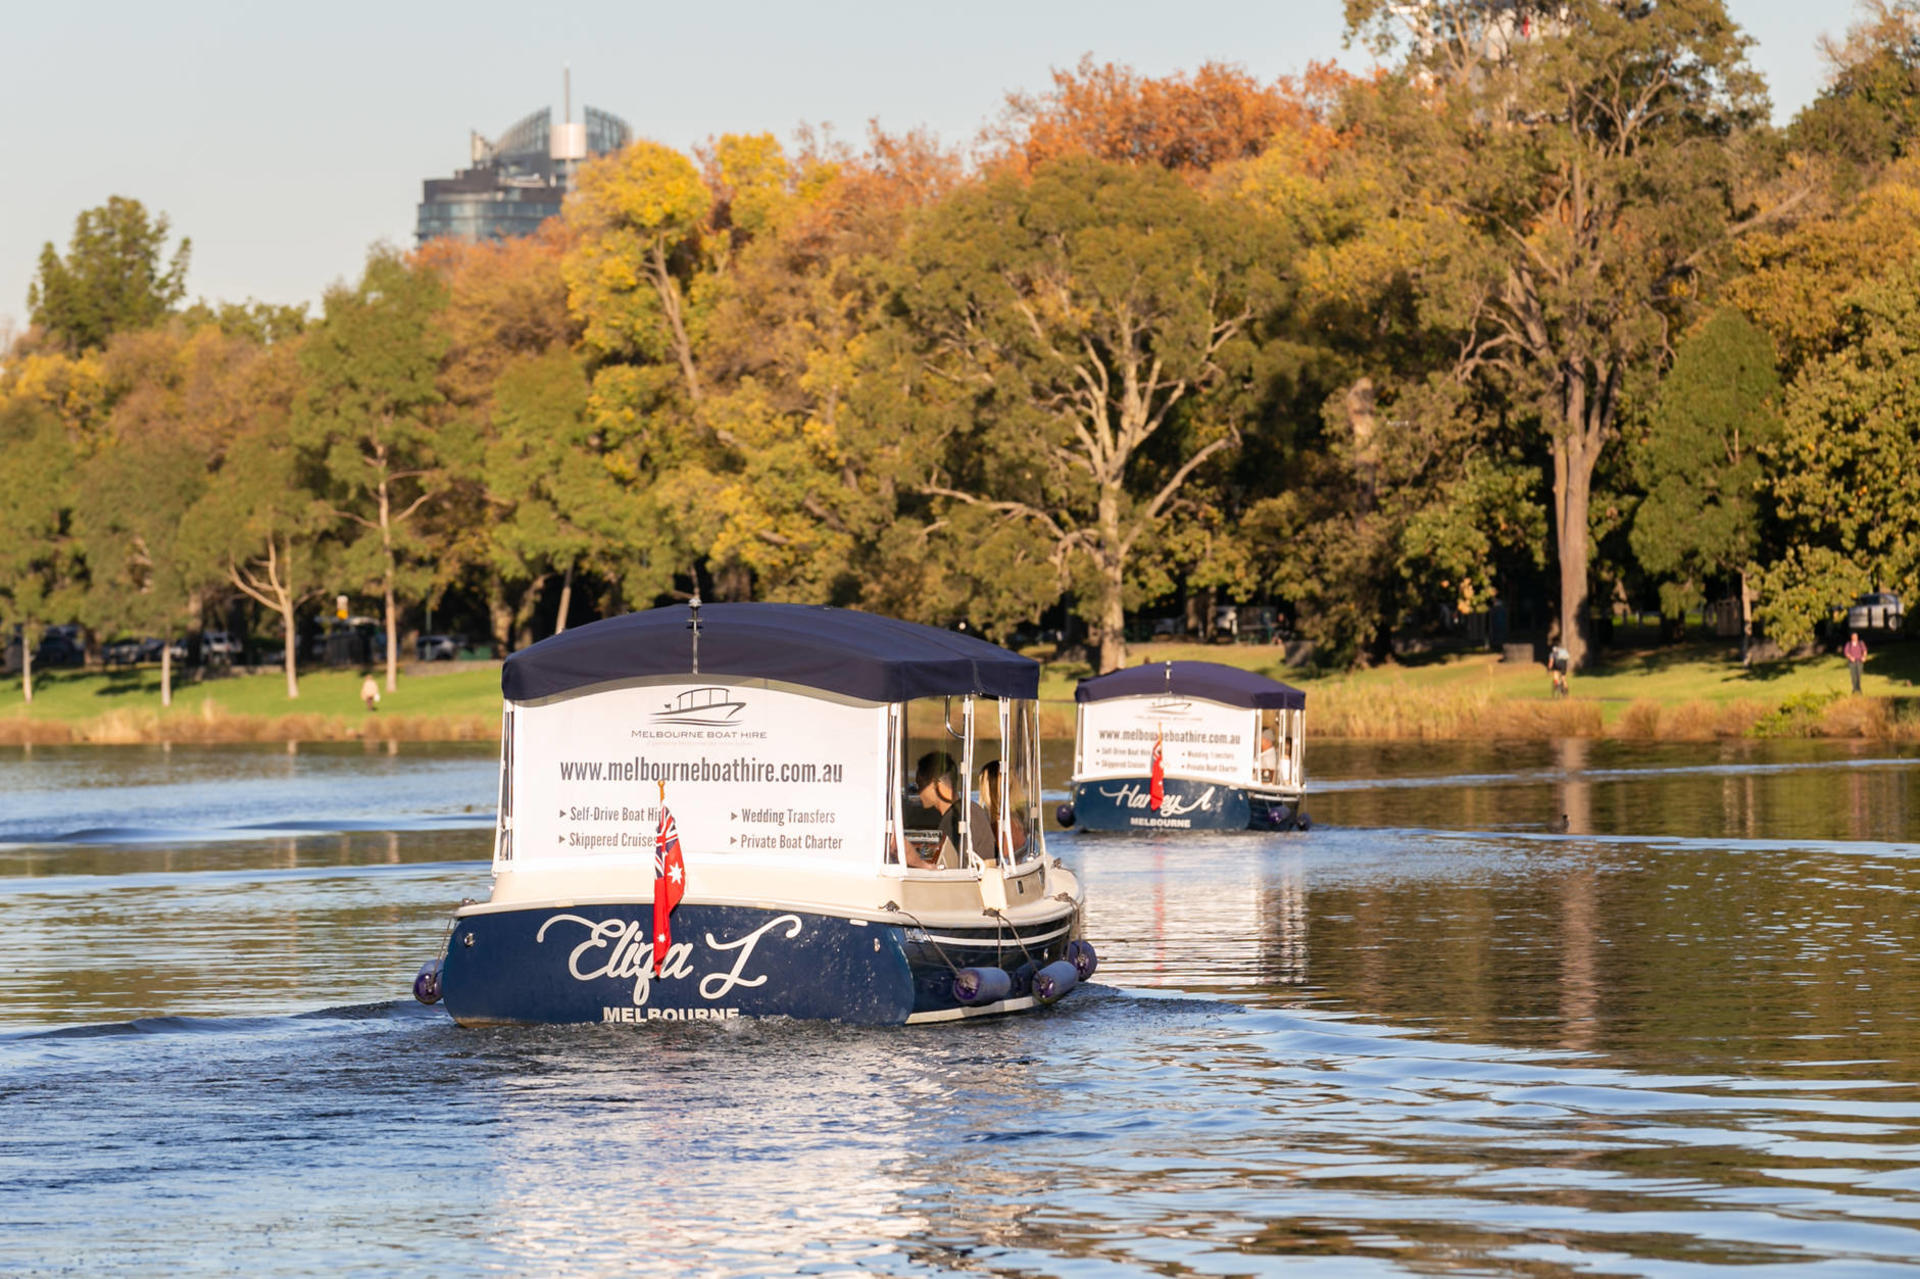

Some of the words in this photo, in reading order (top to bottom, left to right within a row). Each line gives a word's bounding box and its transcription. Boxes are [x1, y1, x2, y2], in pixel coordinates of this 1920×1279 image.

[631, 730, 704, 739] MELBOURNE
[707, 731, 738, 739] BOAT
[741, 731, 768, 740] HIRE
[1099, 728, 1240, 744] www.melboueboathire.com.au
[560, 757, 843, 782] www.melbourneboathire.com.au
[1099, 784, 1184, 817] Harey
[570, 806, 620, 821] Self-Drive
[622, 807, 645, 821] Boat
[648, 807, 662, 821] Hir
[741, 808, 785, 826] Wedding
[787, 809, 836, 823] Transfers
[1130, 817, 1191, 828] MELBOURNE
[569, 832, 619, 849] Skippered
[740, 834, 777, 848] Private
[779, 834, 803, 849] Boat
[805, 834, 843, 849] Charter
[603, 1007, 740, 1023] MELBOURNE
